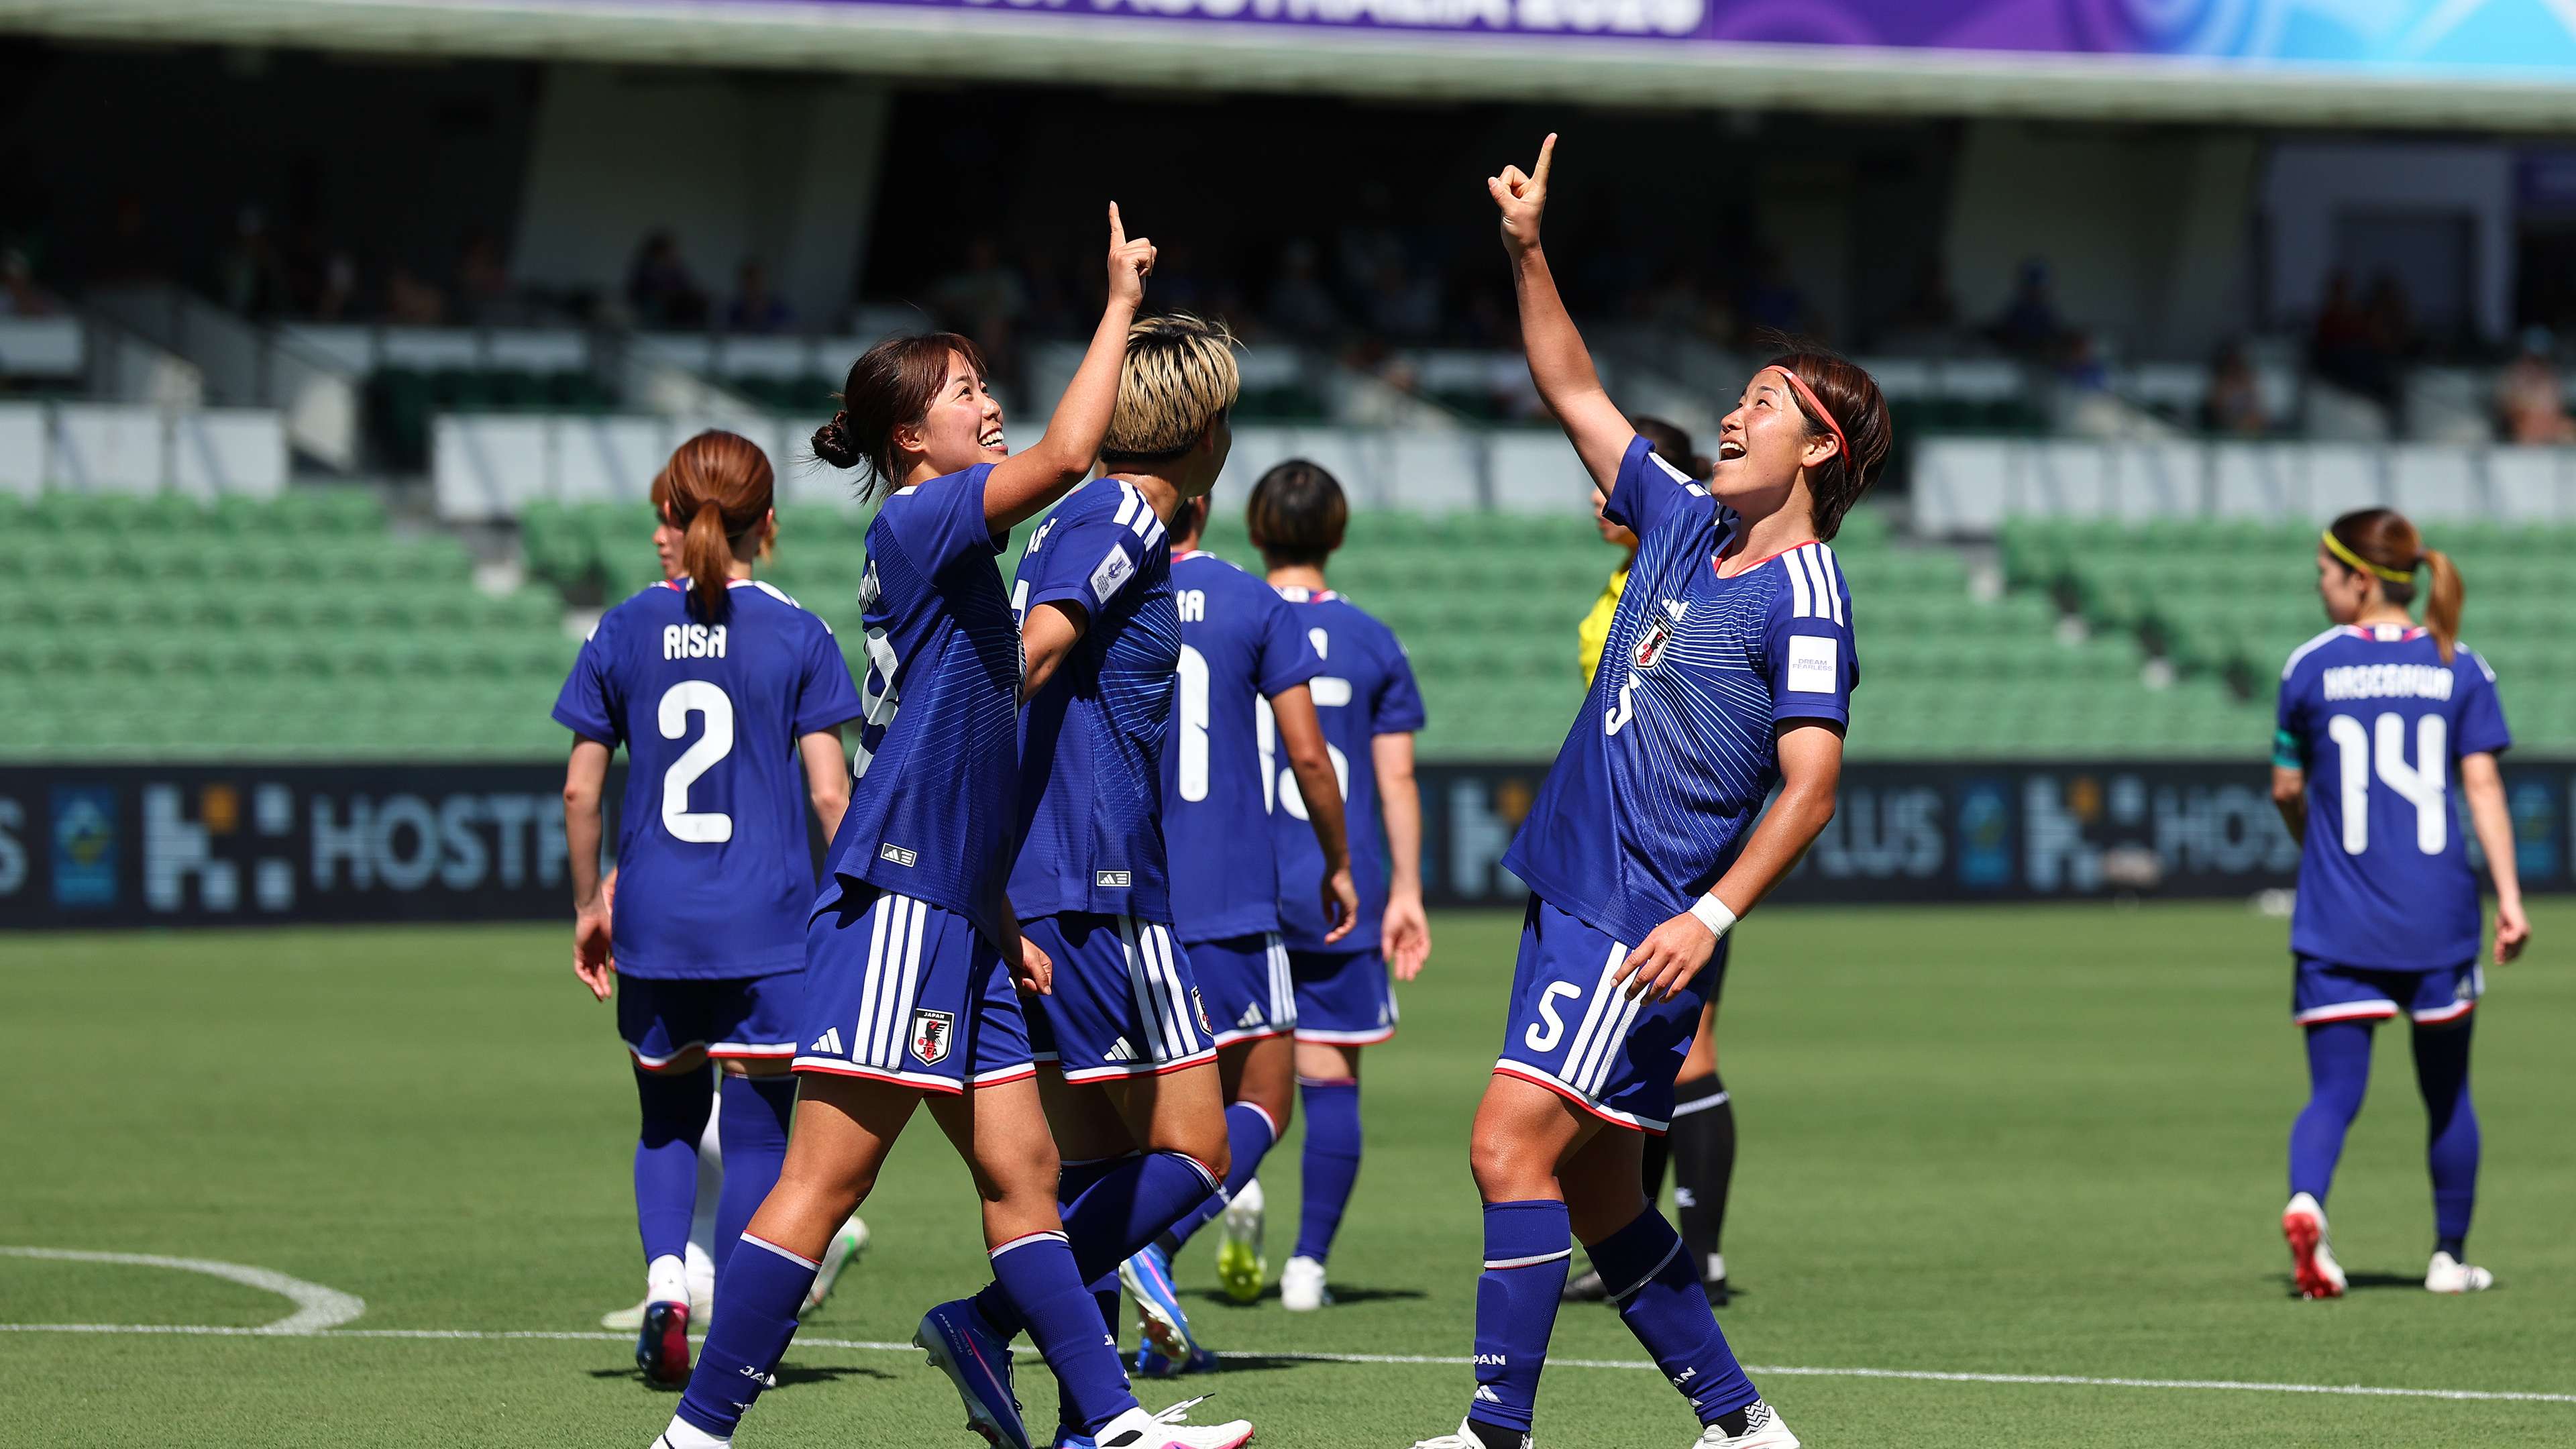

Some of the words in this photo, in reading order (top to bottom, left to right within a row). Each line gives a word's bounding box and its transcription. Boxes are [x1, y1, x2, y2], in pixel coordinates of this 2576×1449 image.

[663, 624, 727, 660] RISA
[1792, 663, 1833, 672] FEARLESS
[658, 680, 734, 843] 2
[2328, 712, 2447, 856] 14
[923, 1012, 945, 1020] JAPAN
[1525, 981, 1582, 1053] 5
[920, 1046, 938, 1057] JFA
